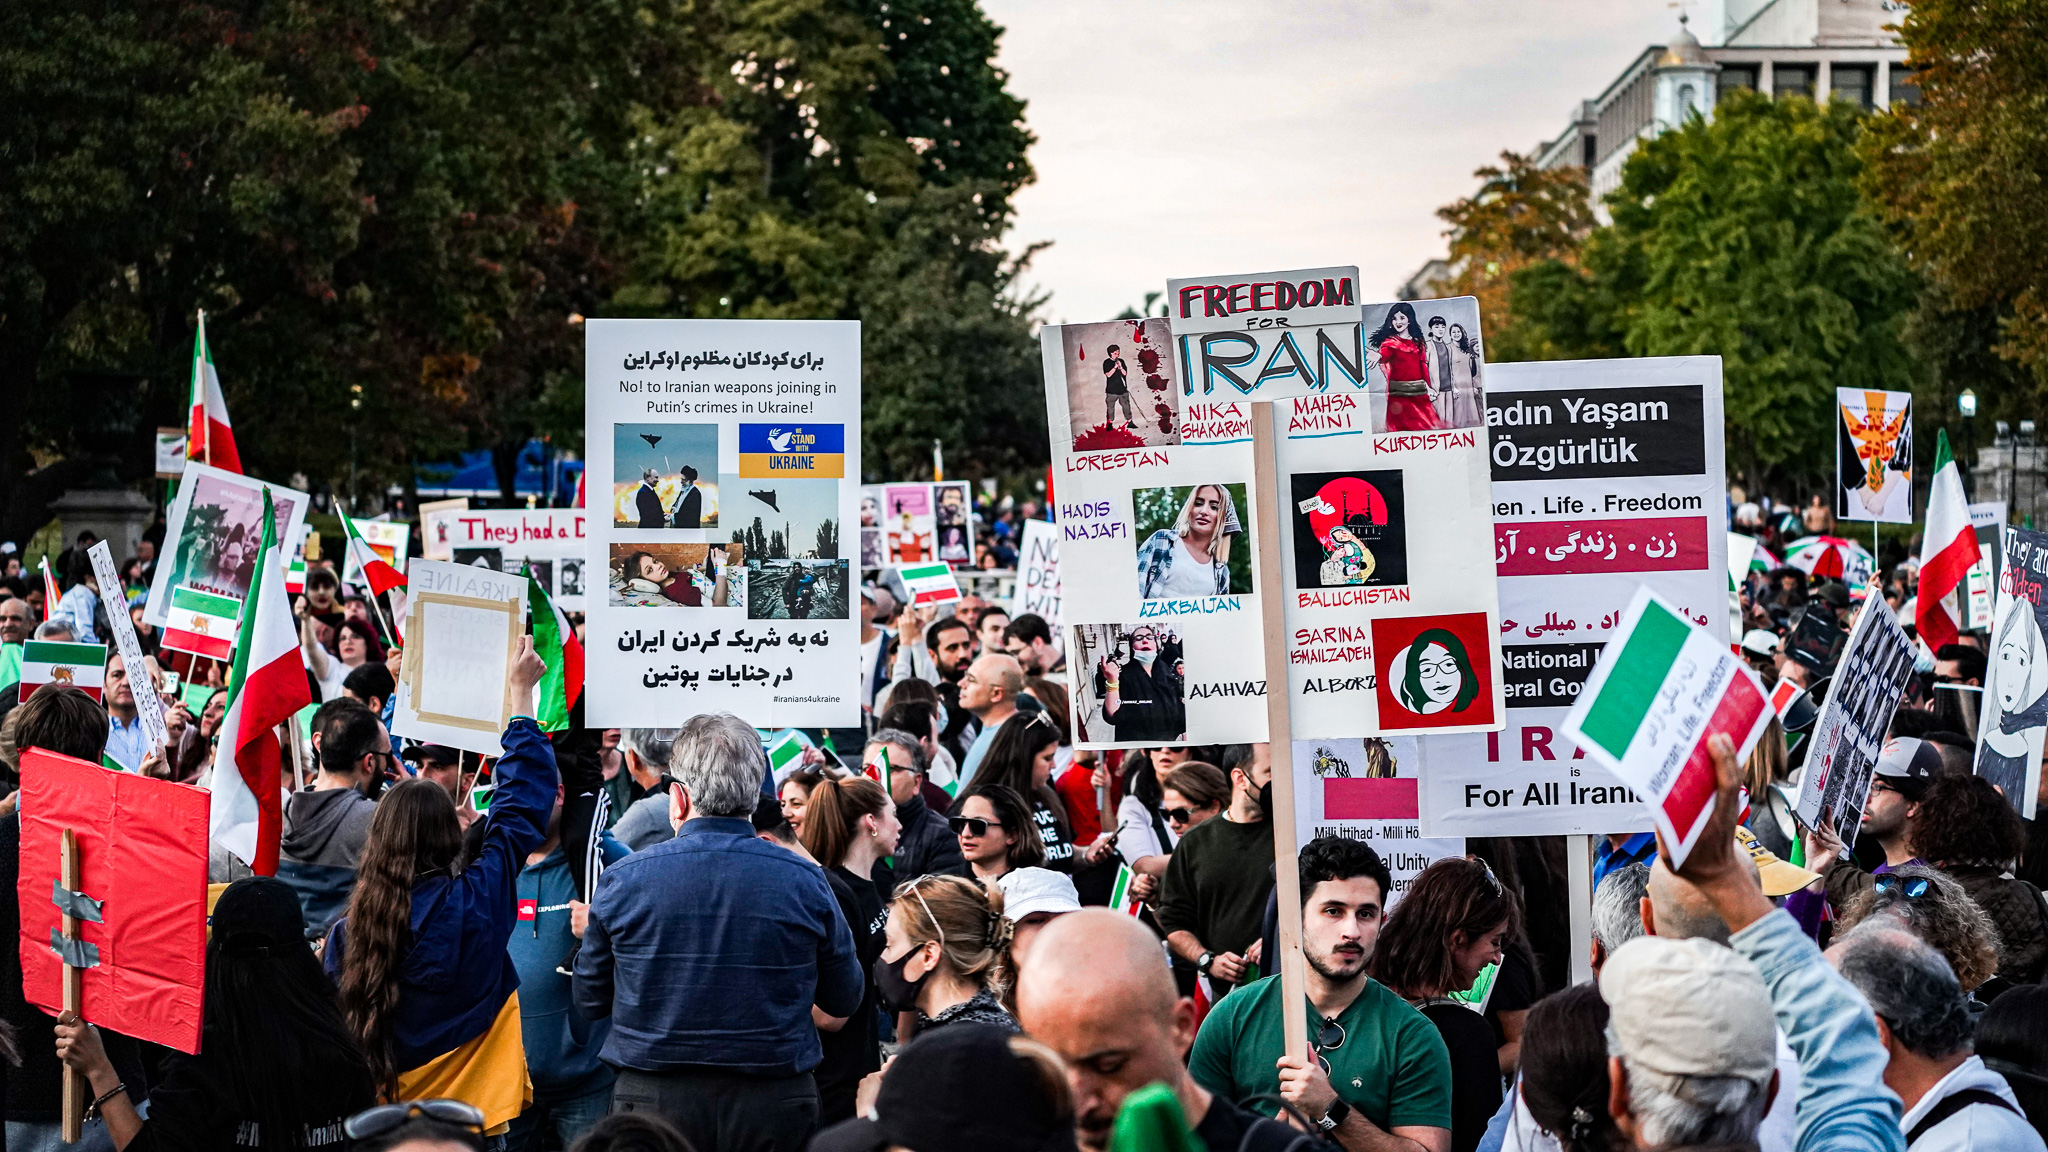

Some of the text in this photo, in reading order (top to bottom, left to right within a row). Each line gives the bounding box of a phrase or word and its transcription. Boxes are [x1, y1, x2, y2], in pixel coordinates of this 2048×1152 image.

[1179, 278, 1354, 318] FREEDOM
[1246, 317, 1292, 330] FOR
[623, 350, 824, 371] برای کودکان مظلوم اوکراین
[1178, 322, 1369, 396] IRAN
[619, 380, 837, 396] No! to Iranian weapons joining in
[694, 402, 738, 414] crimes
[742, 402, 753, 414] in
[758, 401, 813, 414] Ukraine!
[1189, 402, 1243, 421] NIKA
[1294, 394, 1356, 416] MAHSA
[1486, 398, 1669, 429] adın Yaşam
[1181, 419, 1253, 439] SHAKARAMI
[1289, 414, 1351, 432] AMINI
[791, 434, 815, 444] STAND
[1373, 431, 1475, 455] KURDISTAN
[769, 455, 814, 469] UKRAINE
[1066, 451, 1169, 473] LORESTAN
[1493, 435, 1638, 471] Özgürlük
[1062, 501, 1110, 519] HADIS
[1544, 496, 1584, 514] Life
[1604, 493, 1702, 513] Freedom
[459, 517, 518, 543] They
[523, 516, 553, 540] had
[558, 527, 568, 538] a
[1065, 522, 1127, 541] NAJAFI
[1545, 529, 1617, 562] زندگی
[1645, 531, 1678, 558] زن
[2007, 527, 2048, 578] They arr
[1027, 567, 1060, 589] DE
[2001, 563, 2042, 606] children
[1026, 593, 1061, 615] WIT
[1139, 596, 1241, 618] AZARBAIJAN
[1298, 587, 1410, 608] BALUCHISTAN
[618, 627, 829, 654] نه به شریک کردن ایران
[1295, 626, 1366, 646] SARINA
[1291, 646, 1372, 664] ISMAILZADEH
[1501, 649, 1587, 670] National
[643, 664, 793, 691] در جنایات پوتین
[1303, 675, 1377, 694] ALBORZ
[1503, 678, 1542, 698] eral
[1691, 654, 1732, 713] Freedom
[773, 695, 840, 703] #iranians4ukraine
[1189, 681, 1267, 699] ALAHVAZ
[1570, 767, 1581, 777] is
[1465, 782, 1645, 807] For All Irani
[1038, 827, 1059, 843] HE
[1383, 826, 1403, 839] Milli
[1397, 853, 1430, 871] Unity
